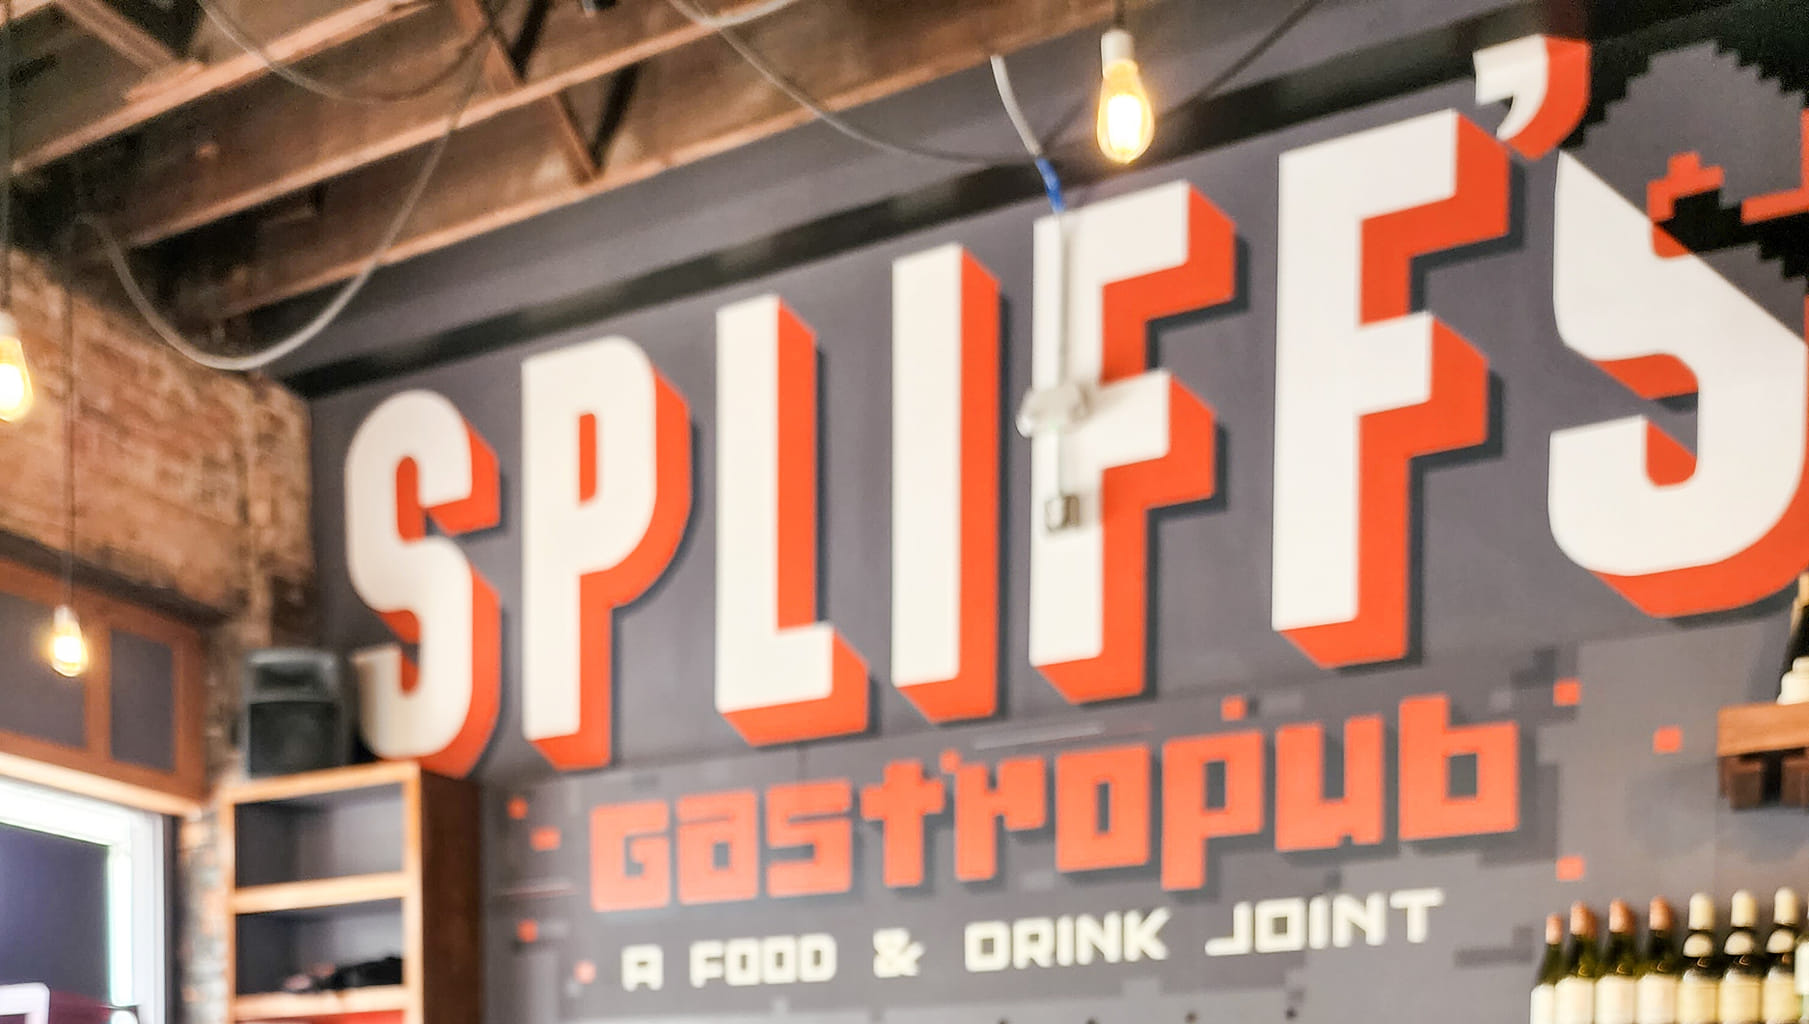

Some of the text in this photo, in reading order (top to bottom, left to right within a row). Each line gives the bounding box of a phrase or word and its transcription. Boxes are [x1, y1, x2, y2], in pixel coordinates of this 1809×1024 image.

[345, 34, 1809, 777] SPLIFF'S
[621, 887, 1445, 992] A FOOD & DRINK JOINT
